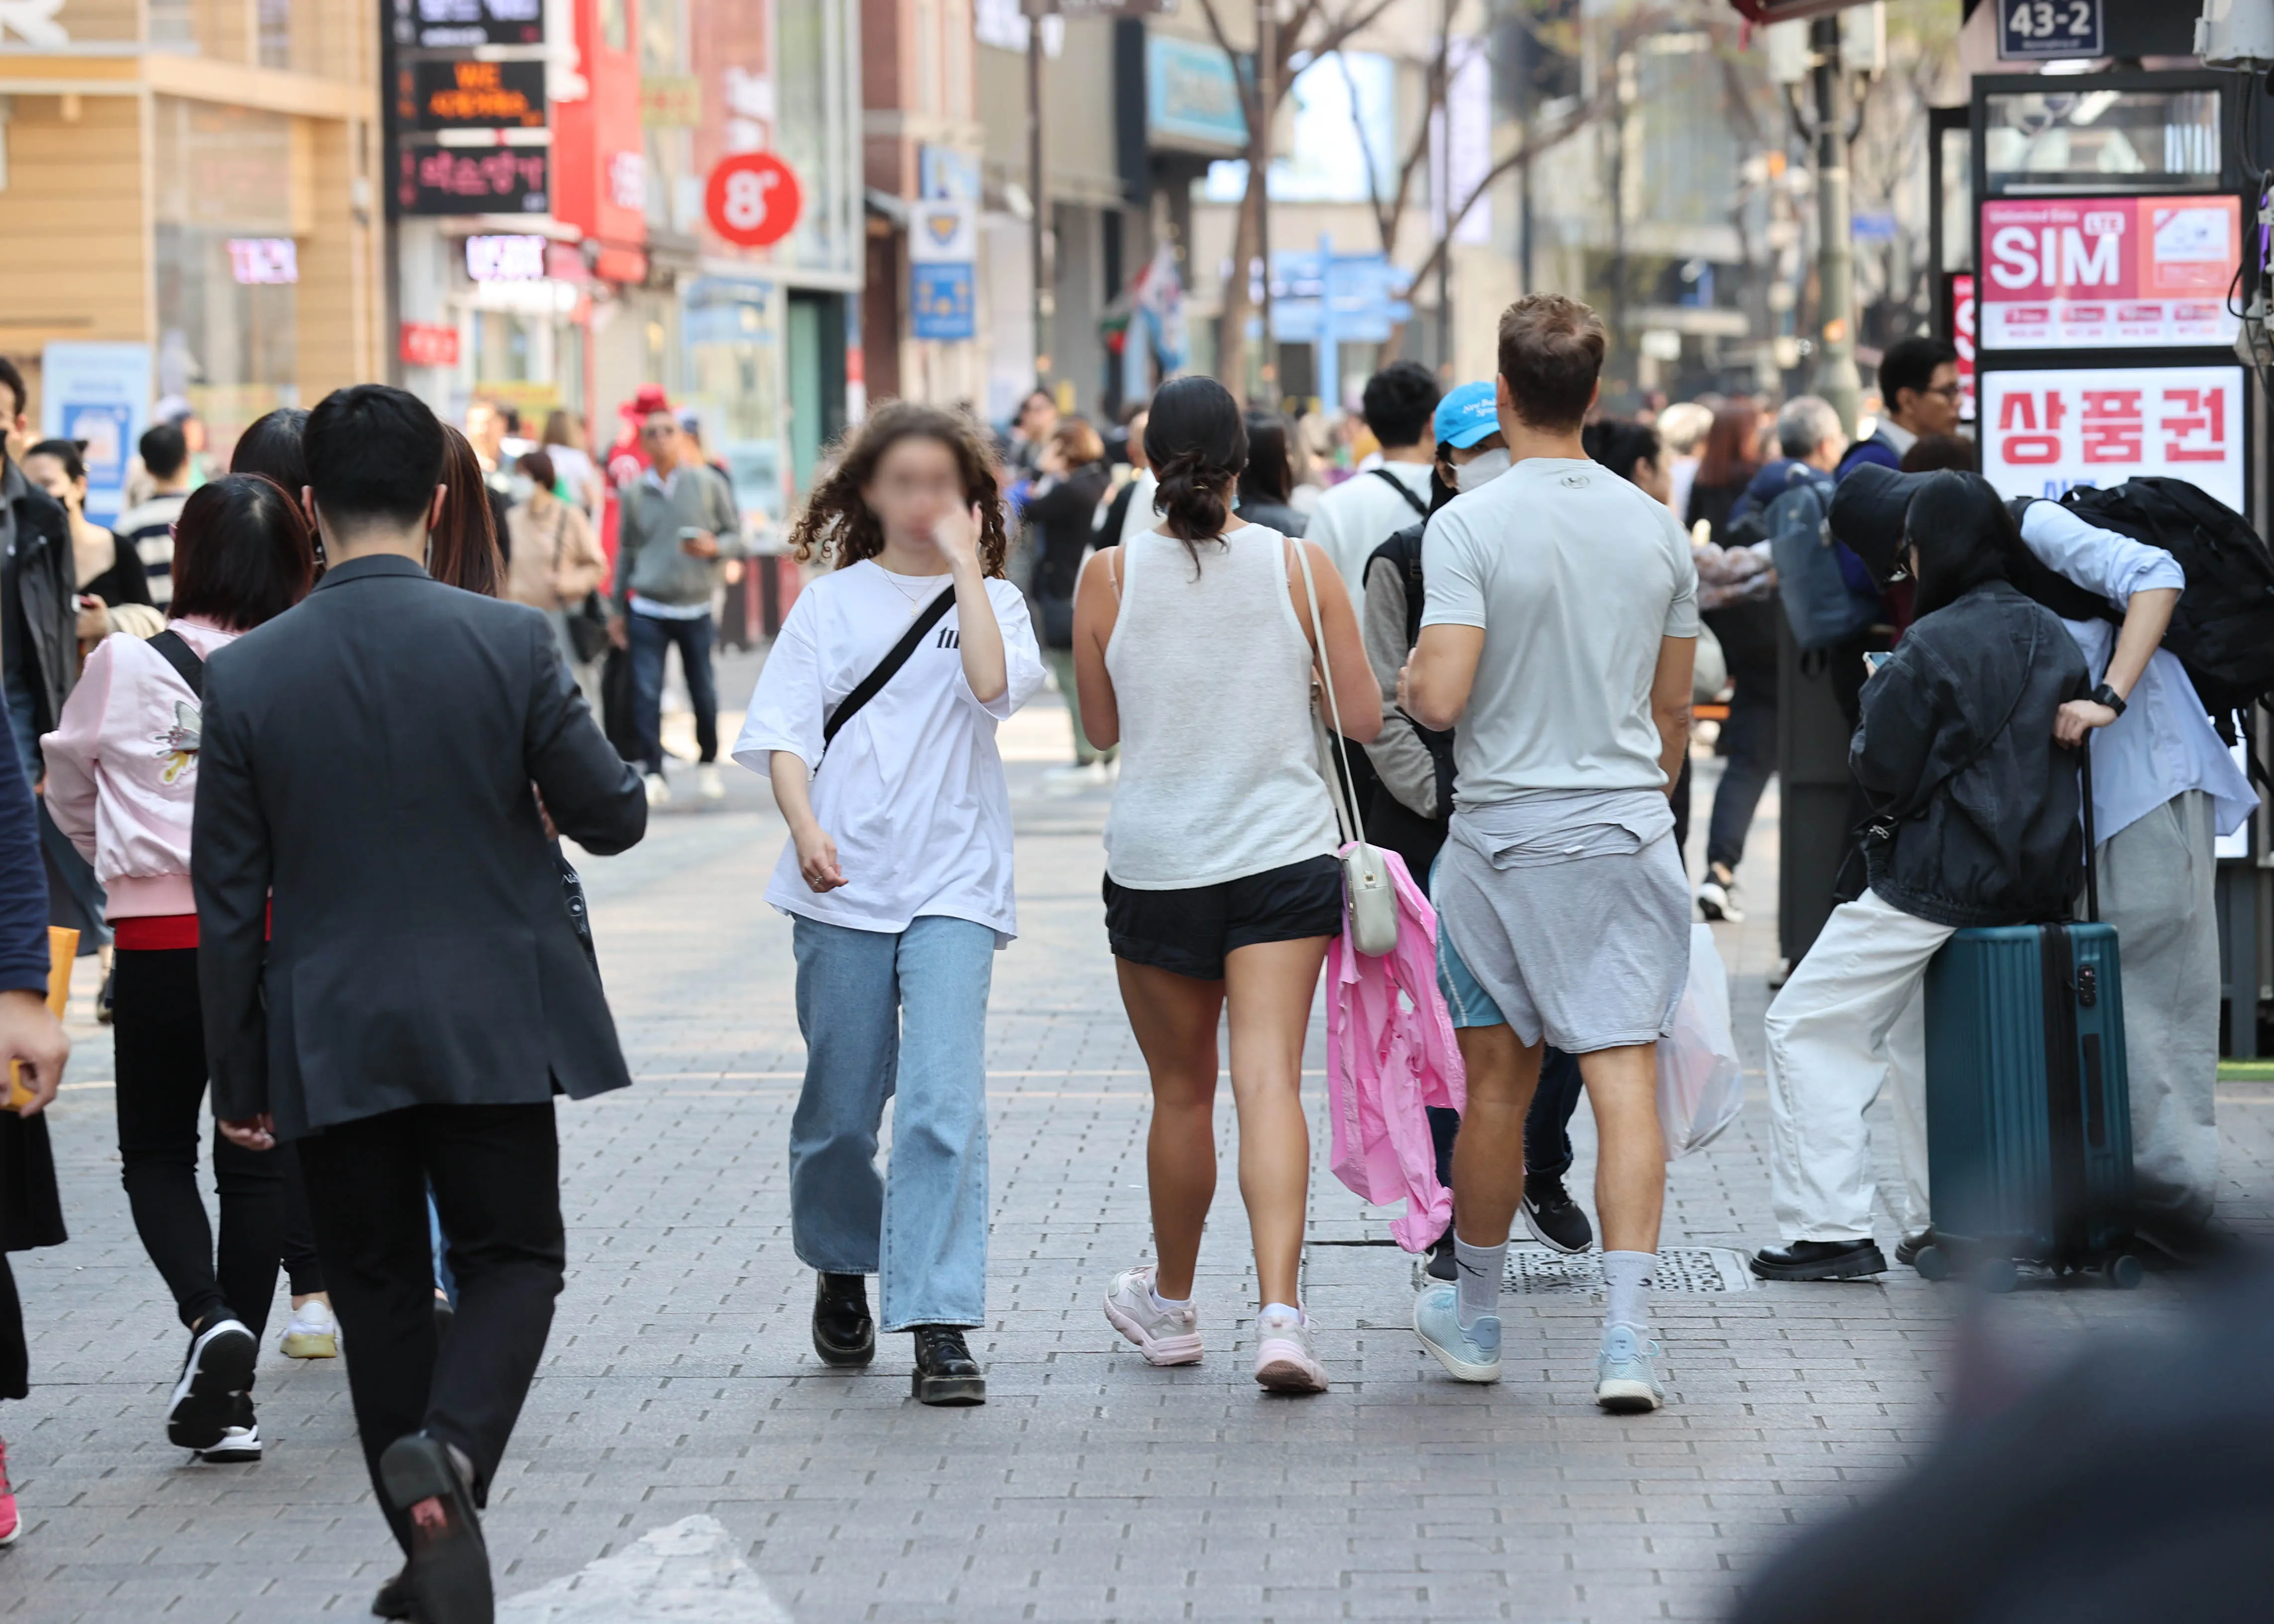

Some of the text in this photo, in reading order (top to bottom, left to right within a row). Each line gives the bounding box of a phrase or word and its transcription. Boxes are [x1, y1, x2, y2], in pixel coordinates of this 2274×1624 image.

[2009, 1, 2092, 37] 43-2
[1990, 226, 2120, 289] SIM
[1998, 387, 2226, 465] 상품권
